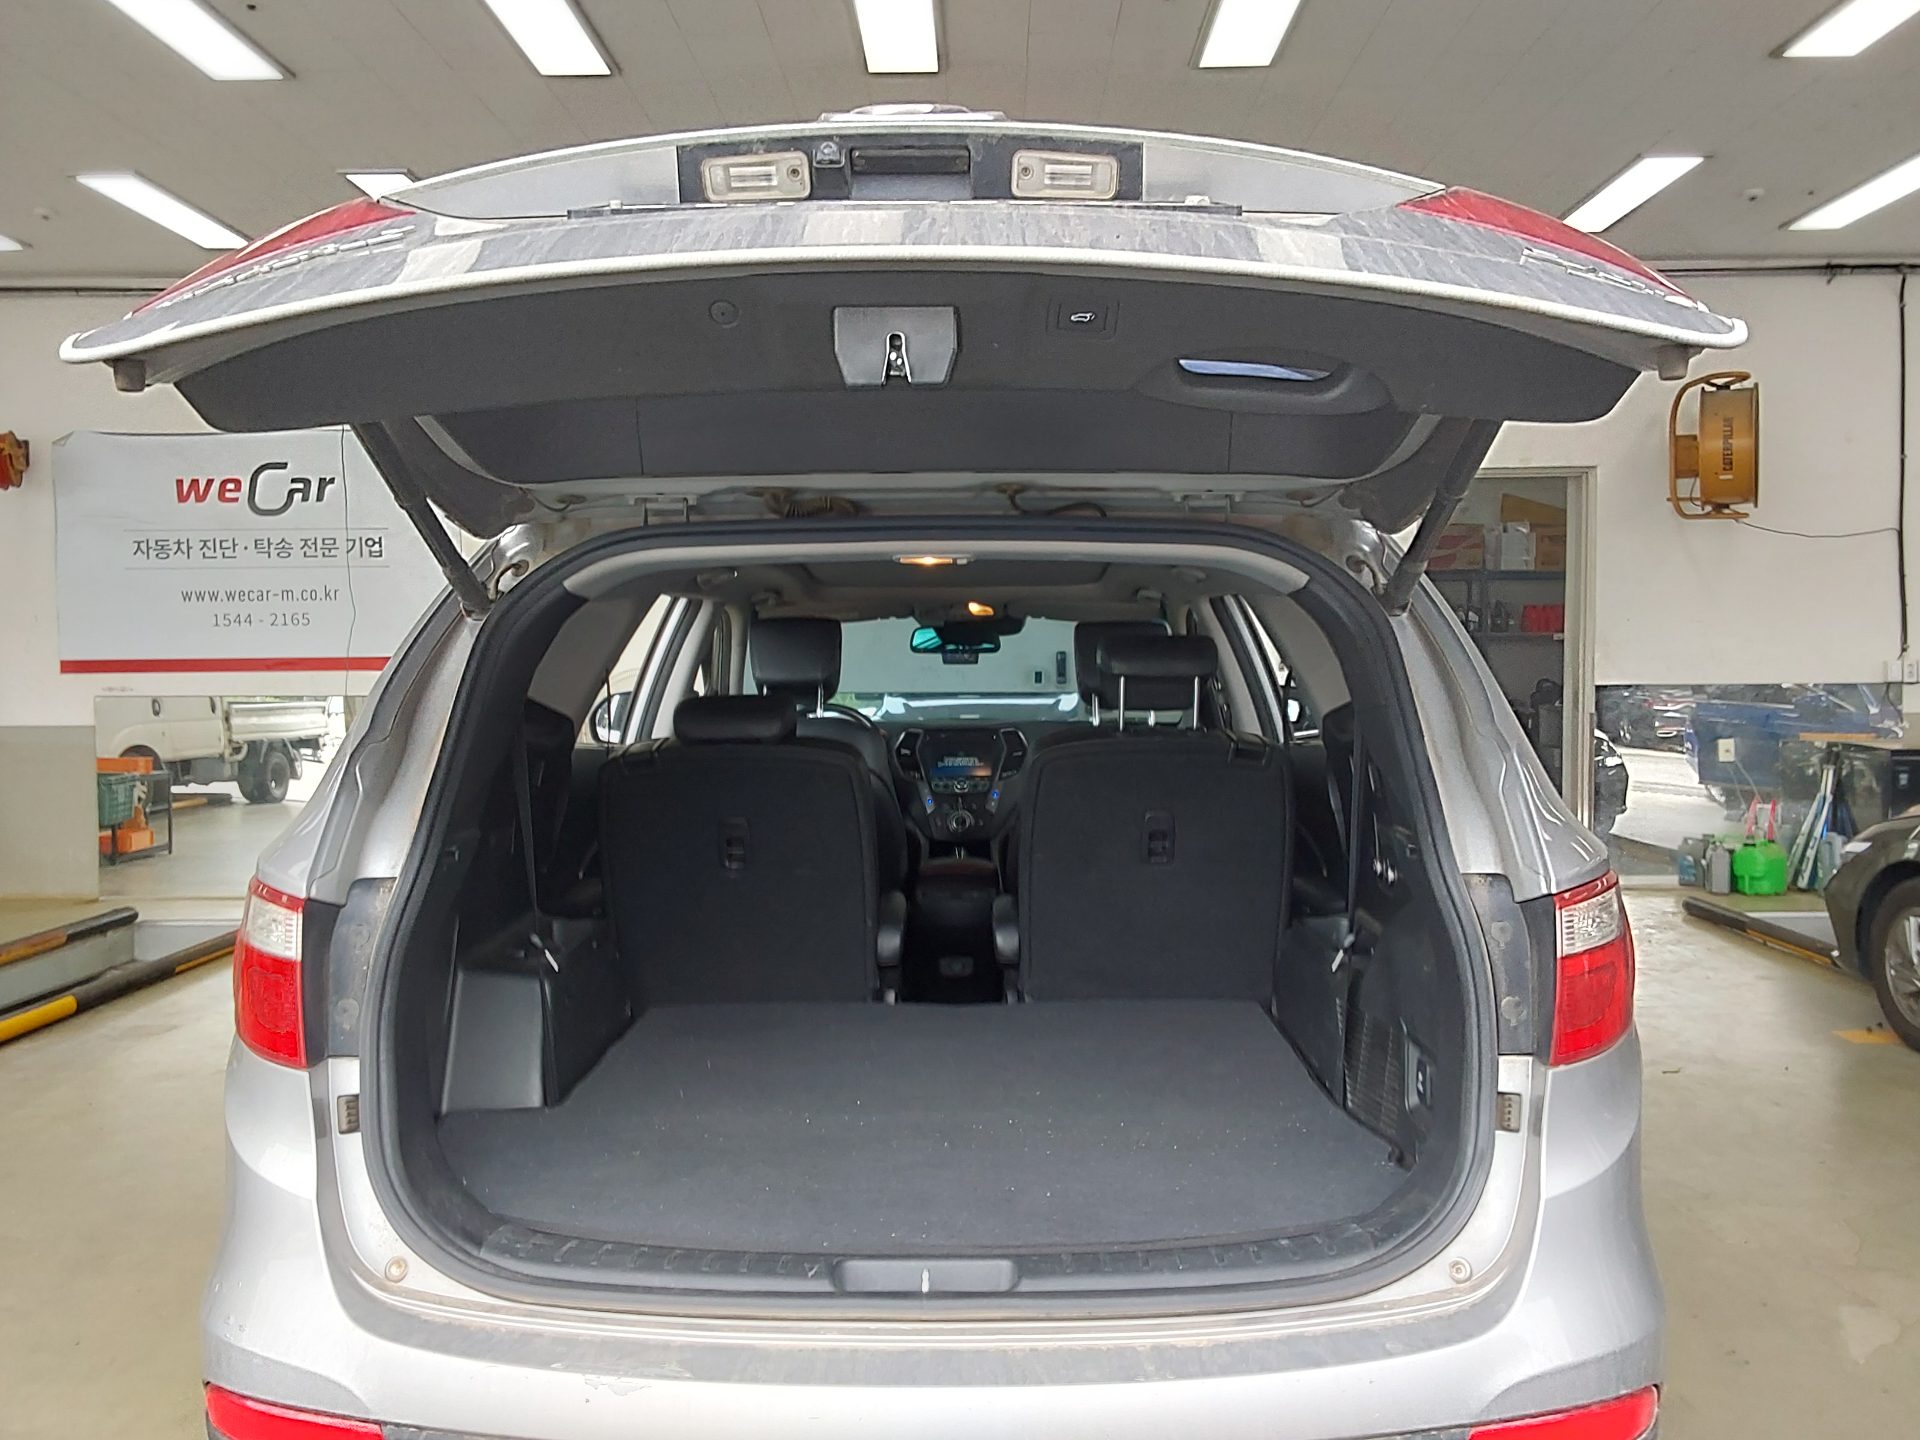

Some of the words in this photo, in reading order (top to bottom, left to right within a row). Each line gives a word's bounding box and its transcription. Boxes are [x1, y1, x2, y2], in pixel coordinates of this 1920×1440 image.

[132, 538, 193, 560] 자동차
[299, 536, 340, 559] 전문
[345, 536, 384, 558] 기업
[180, 585, 340, 602] www.wecar-m.co.kr
[213, 612, 252, 628] 1544
[269, 612, 311, 627] 2165
